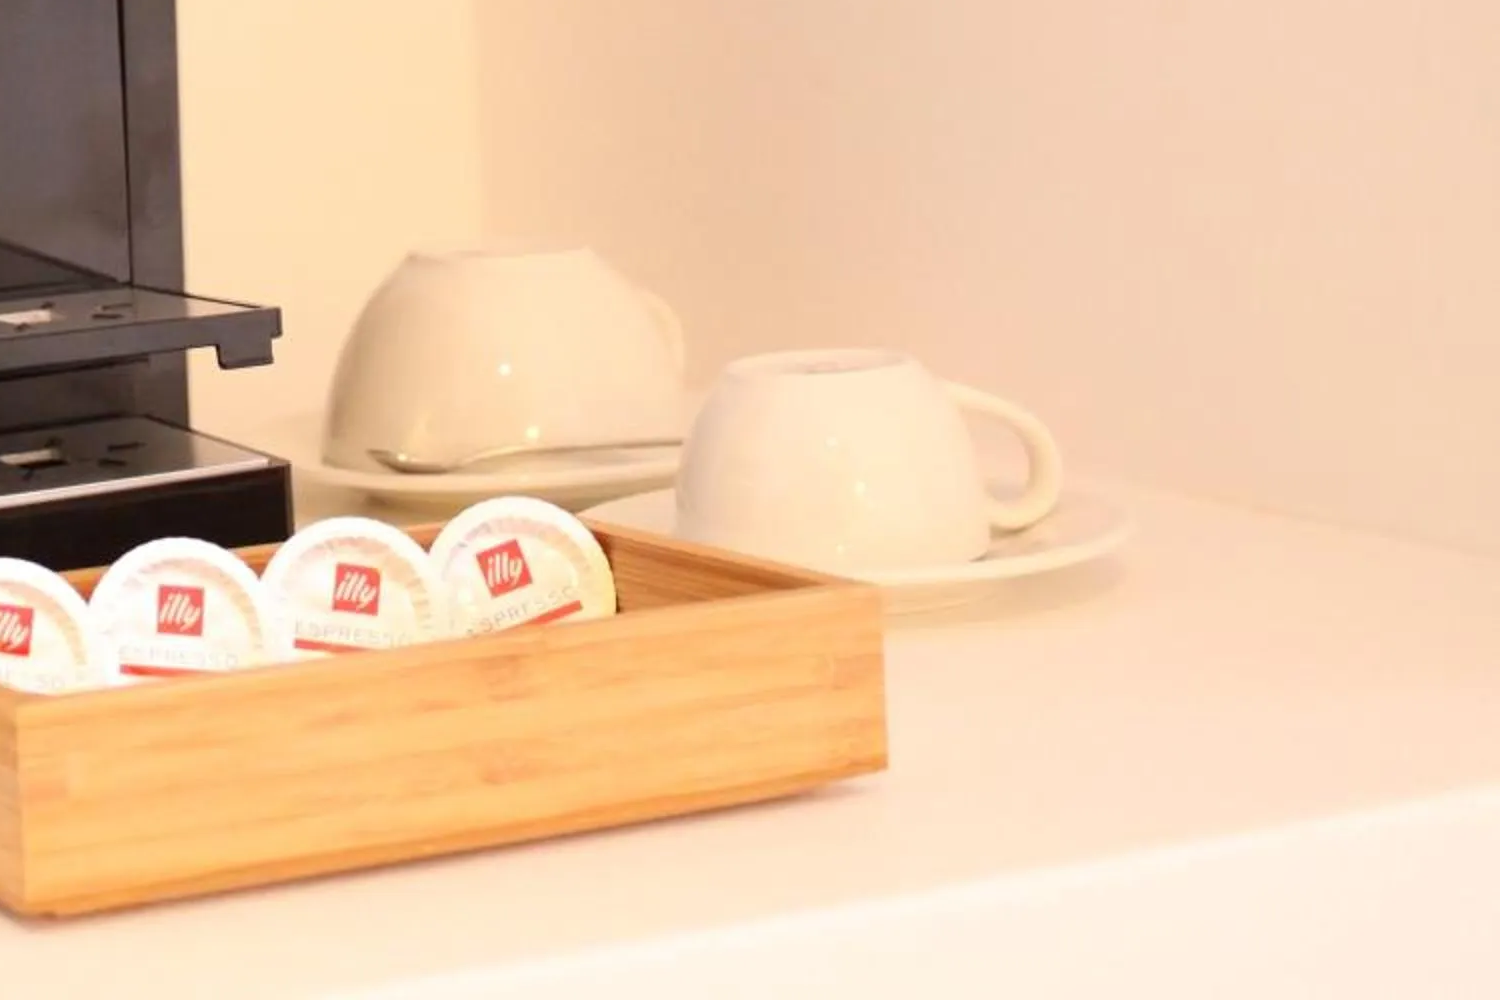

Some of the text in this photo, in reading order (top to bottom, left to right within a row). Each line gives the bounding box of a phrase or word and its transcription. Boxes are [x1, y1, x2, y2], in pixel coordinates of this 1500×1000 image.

[484, 549, 524, 589] illy
[335, 570, 379, 610] illy
[157, 592, 202, 632] illy
